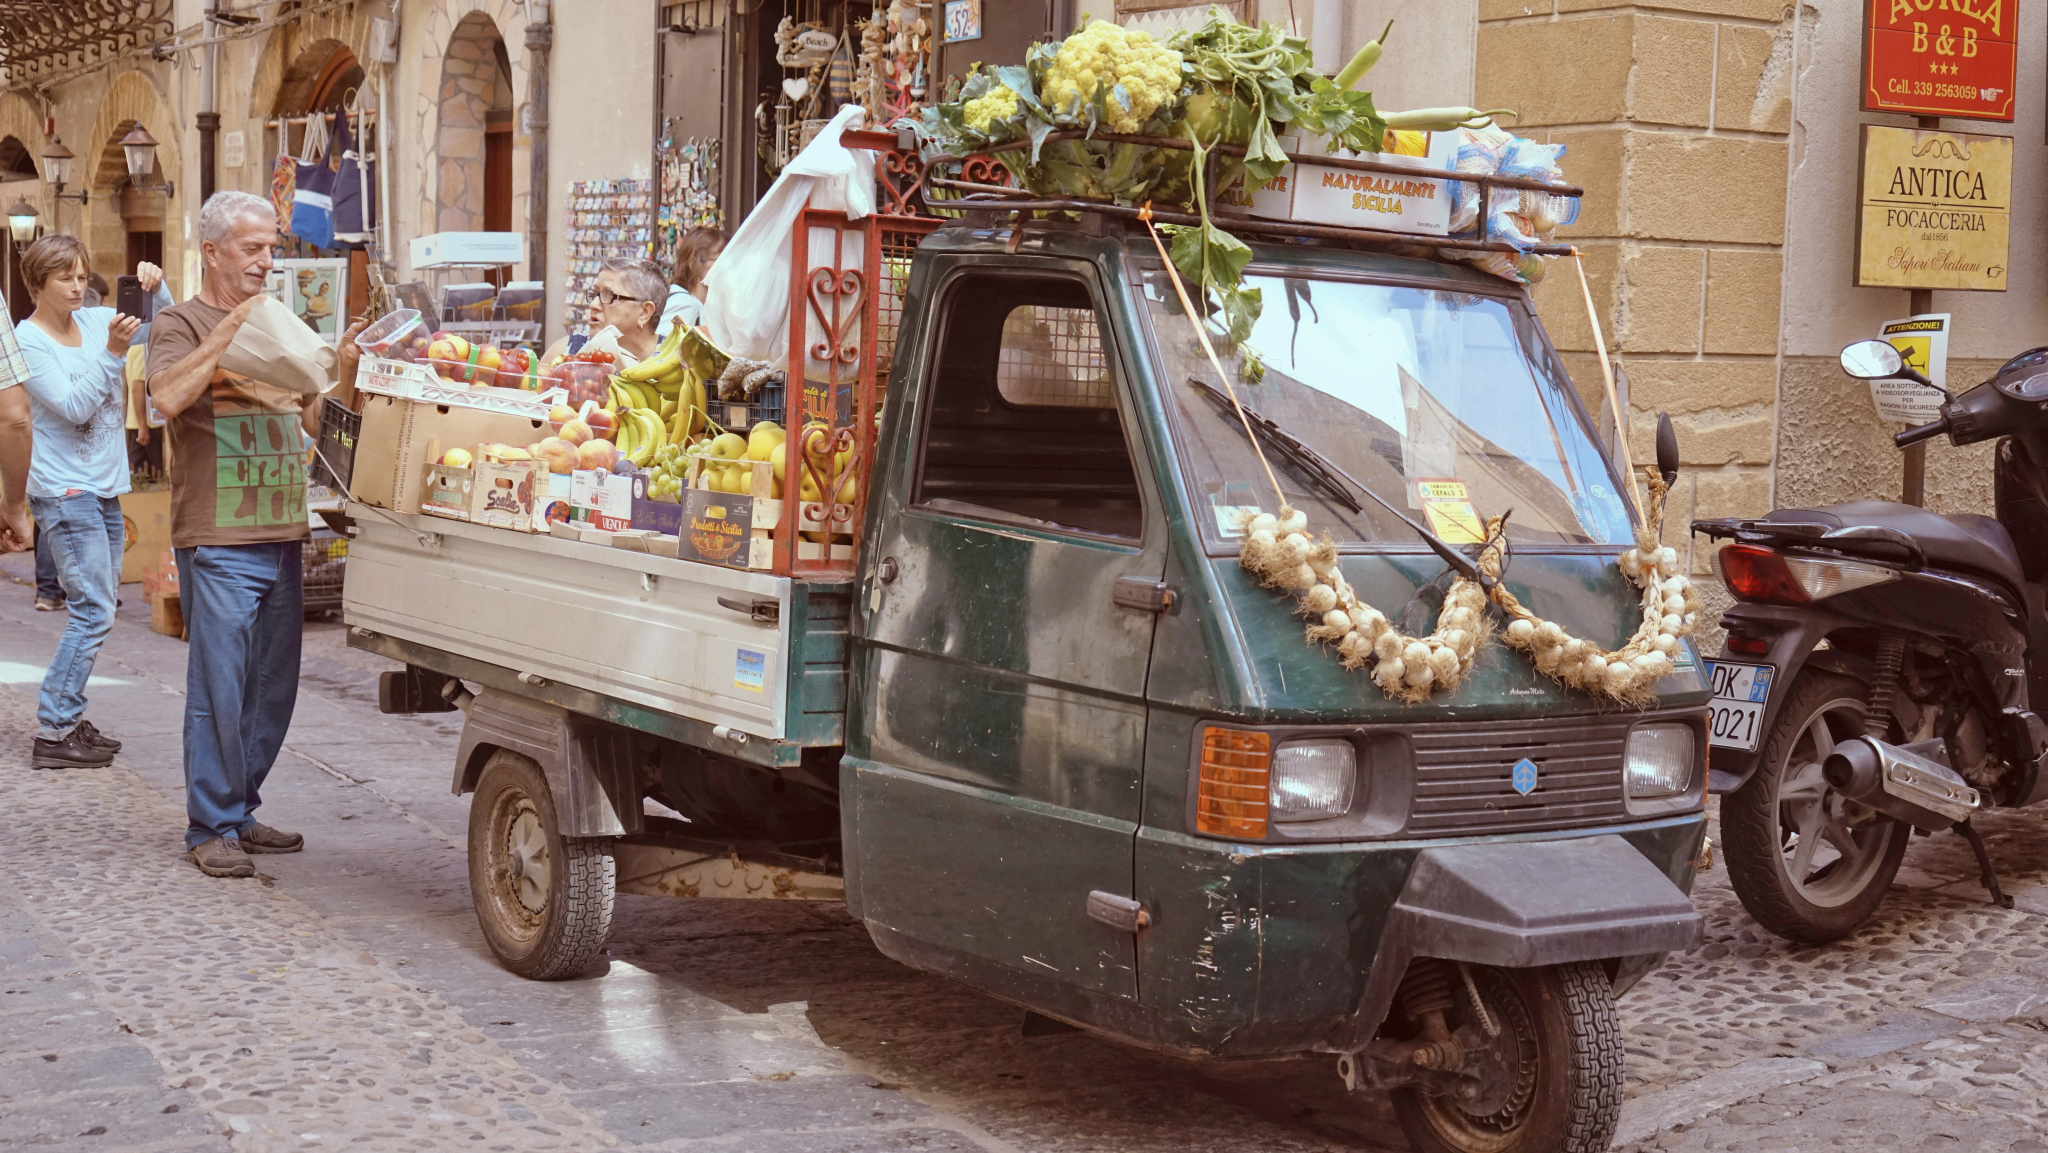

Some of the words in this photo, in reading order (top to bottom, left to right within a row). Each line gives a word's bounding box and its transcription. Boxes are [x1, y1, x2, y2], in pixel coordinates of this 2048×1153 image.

[954, 8, 969, 38] 52
[805, 36, 828, 47] Beach
[1912, 21, 1929, 53] B
[1935, 24, 1955, 56] &
[1962, 26, 1978, 58] B
[1888, 78, 1911, 95] Cell.
[1913, 81, 1933, 96] 339
[1935, 83, 1977, 100] 2563059
[1322, 171, 1437, 200] NATURALMENTE
[1888, 166, 1987, 200] ANTICA
[1352, 192, 1403, 215] SICILIA
[1886, 209, 1986, 232] FOCACCERIA
[1888, 246, 1930, 275] Sapori
[1931, 248, 1981, 273] Siciliani
[1886, 321, 1940, 333] ATTENZIONE!
[398, 463, 408, 498] SUPERVENT
[1712, 665, 1742, 698] DK
[1750, 685, 1765, 700] PA
